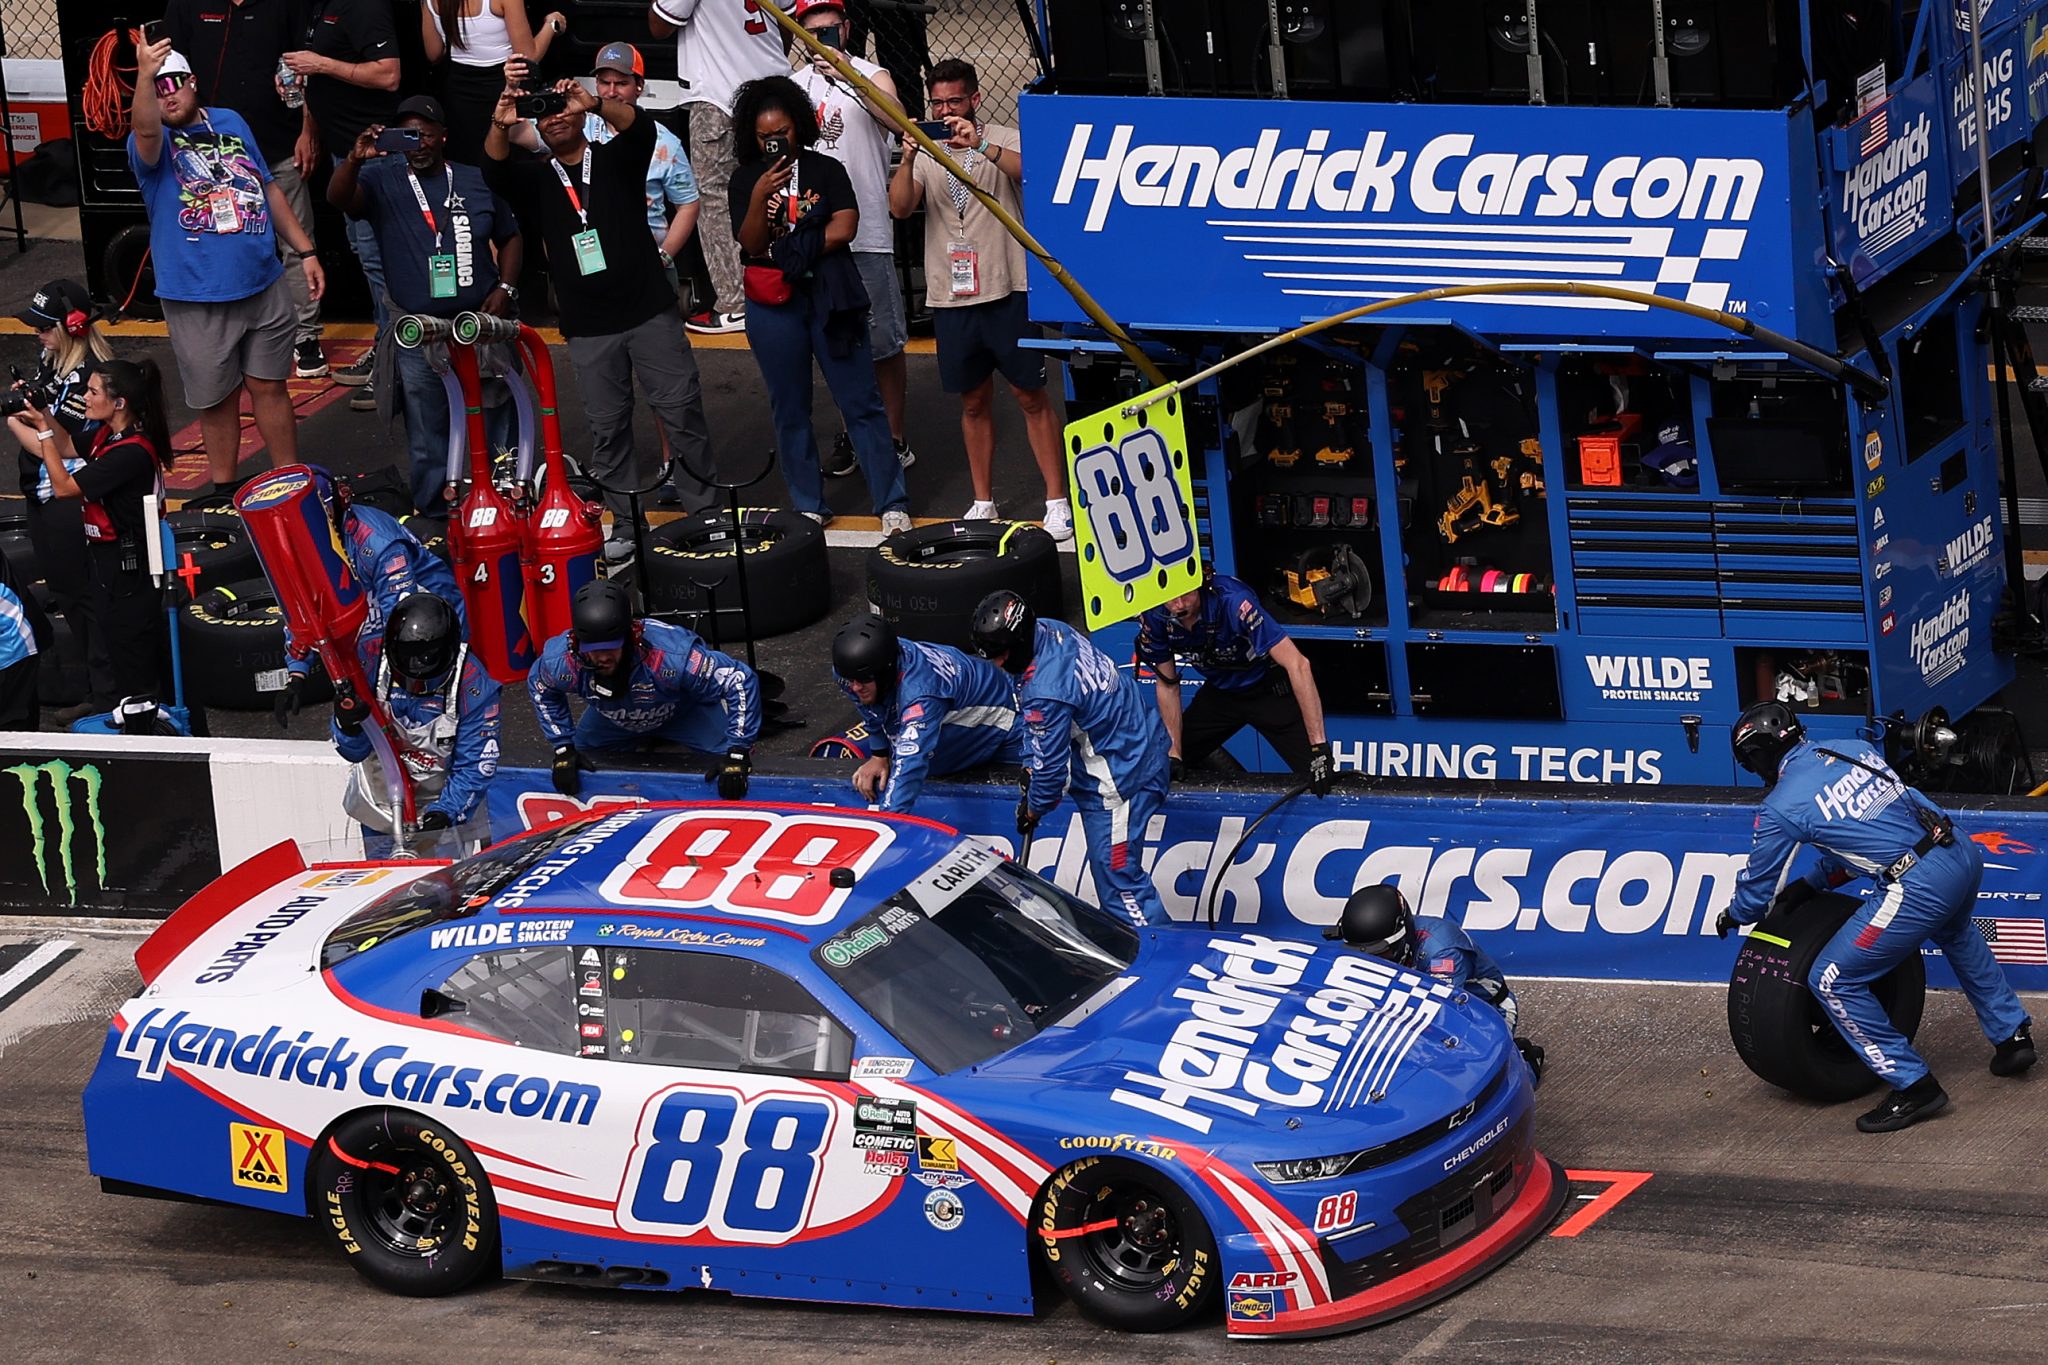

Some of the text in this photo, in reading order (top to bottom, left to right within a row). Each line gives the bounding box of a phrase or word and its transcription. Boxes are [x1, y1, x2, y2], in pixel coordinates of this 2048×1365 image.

[452, 215, 474, 287] COWBOYS
[1728, 300, 1747, 314] TM
[469, 508, 498, 529] 88
[540, 509, 570, 529] 88
[1074, 429, 1195, 584] 88
[1946, 515, 1994, 569] WILDE
[474, 562, 489, 582] 4
[540, 564, 556, 584] 3
[1910, 588, 1970, 665] Hendrick
[1921, 626, 1969, 676] Cars.com
[1585, 656, 1713, 689] WILDE
[1602, 689, 1700, 702] PROTEIN SNACKS
[1332, 740, 1663, 785] HIRING TECHS
[559, 807, 652, 858] HIRING
[600, 811, 896, 925] 88
[932, 847, 991, 892] CARUTH
[494, 854, 573, 909] TECHS
[254, 895, 329, 931] AUTO
[518, 920, 575, 931] PROTEIN
[879, 906, 906, 925] AUTO
[886, 911, 921, 935] PARTS
[430, 922, 514, 949] WILDE
[517, 930, 568, 943] SNACKS
[616, 923, 664, 940] Rajah
[710, 932, 767, 948] Caruth
[823, 925, 888, 966] O'Reilly
[195, 932, 280, 985] PARTS
[584, 1025, 600, 1035] SEM
[1109, 933, 1318, 1135] Hendrick
[1242, 954, 1399, 1108] Cars.com
[868, 1059, 906, 1067] NASCAR
[858, 1104, 894, 1124] O'Reilly
[893, 1116, 913, 1125] PARTS
[895, 1110, 911, 1118] AUTO
[876, 1124, 894, 1132] SERIES
[855, 1133, 915, 1150] COMETIC
[1060, 1134, 1177, 1161] GOODYEAR
[1443, 1116, 1510, 1172] CHEVROLET
[628, 1088, 834, 1237] 88
[865, 1151, 909, 1167] Holley
[865, 1164, 904, 1176] MSD
[920, 1161, 957, 1170] KENNAMETAL
[238, 1168, 282, 1187] KOA
[418, 1129, 481, 1252] GOODYEAR
[928, 1191, 960, 1206] CHAMPION
[327, 1190, 362, 1255] EAGLE
[1315, 1191, 1357, 1232] 88
[1175, 1249, 1208, 1310] EAGLE
[1231, 1272, 1299, 1288] ARP
[1231, 1301, 1271, 1312] SUNOCO
